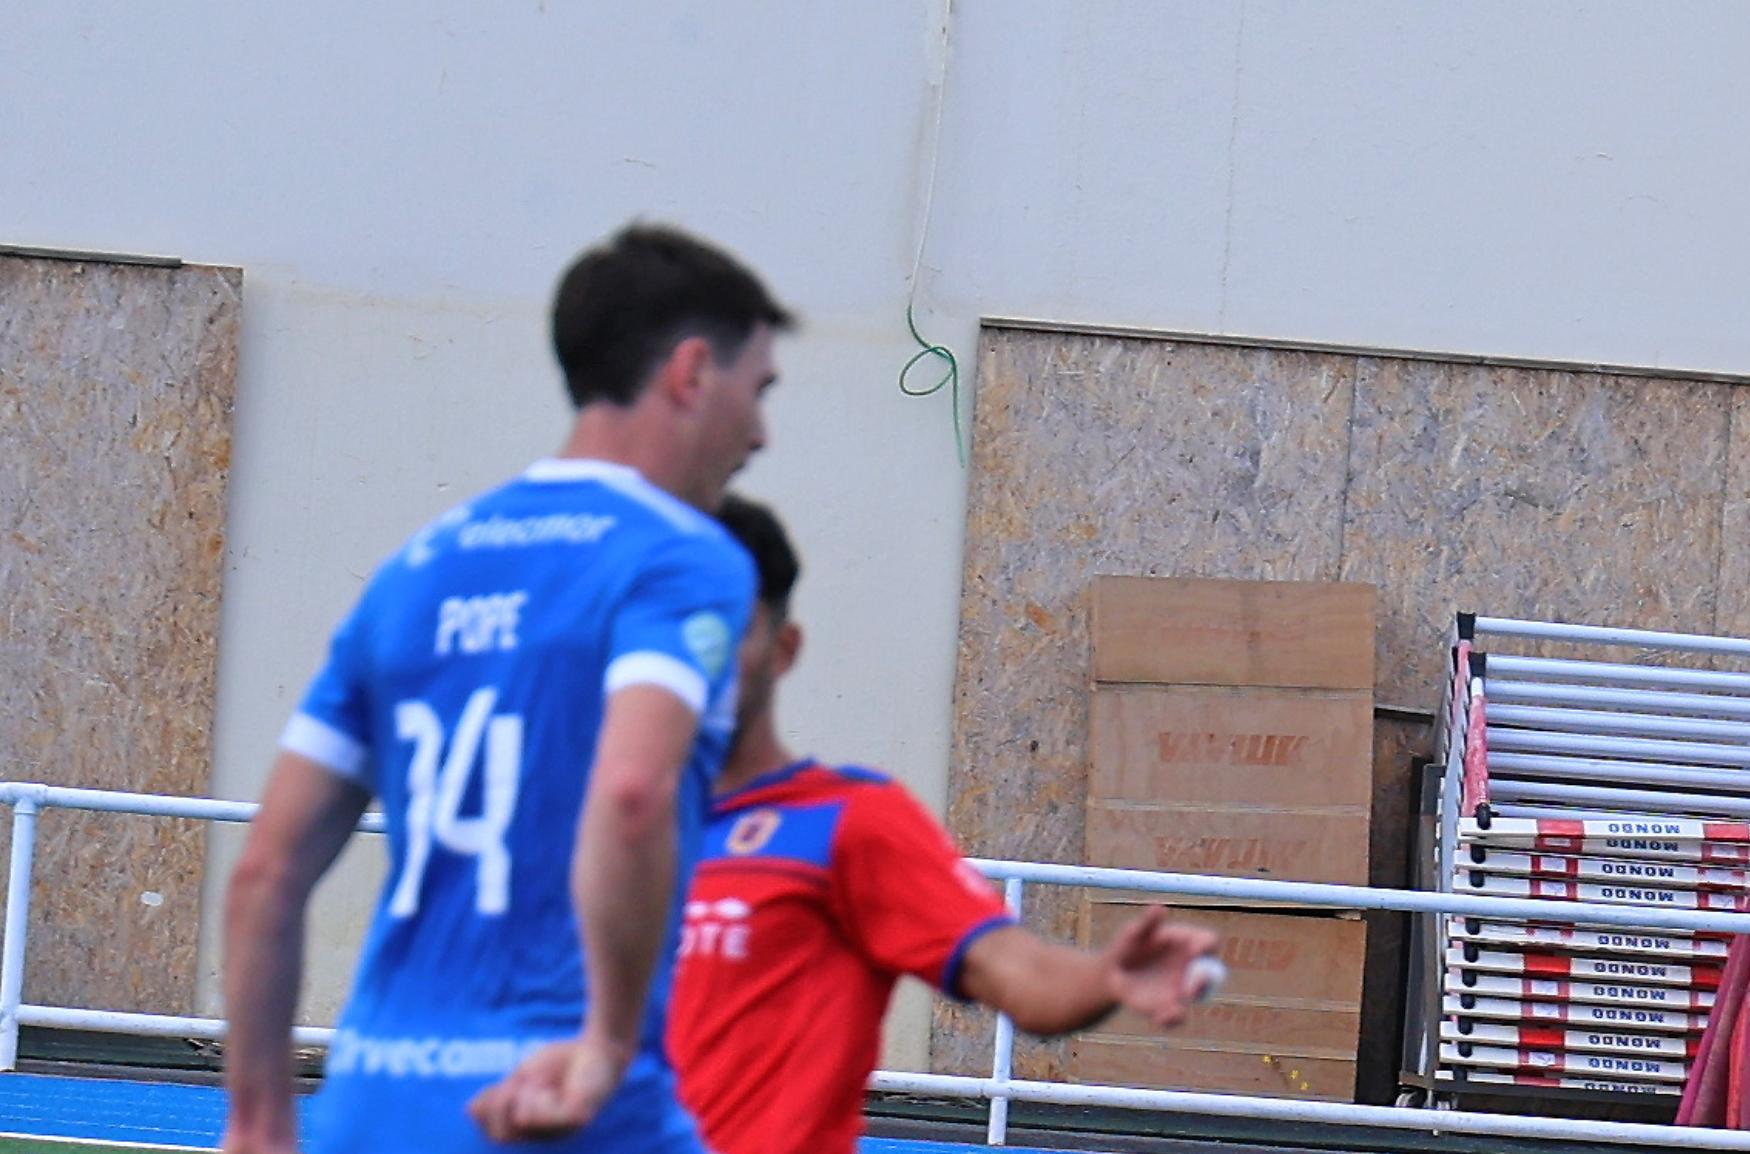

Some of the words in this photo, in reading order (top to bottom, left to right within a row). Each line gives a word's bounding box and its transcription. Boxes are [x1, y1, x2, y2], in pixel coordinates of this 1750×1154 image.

[434, 590, 528, 656] POPE
[389, 687, 523, 917] 14
[1609, 823, 1680, 834] MONDO
[1606, 839, 1678, 851] MONDO
[1602, 863, 1673, 877] MONDO
[1602, 888, 1673, 902] MONDO
[1598, 935, 1670, 949] MONDO
[1594, 962, 1666, 977] MONDO
[1593, 985, 1665, 1000] MONDO
[1592, 1008, 1664, 1023] MONDO
[1588, 1035, 1660, 1049] MONDO
[1588, 1058, 1660, 1073] MONDO
